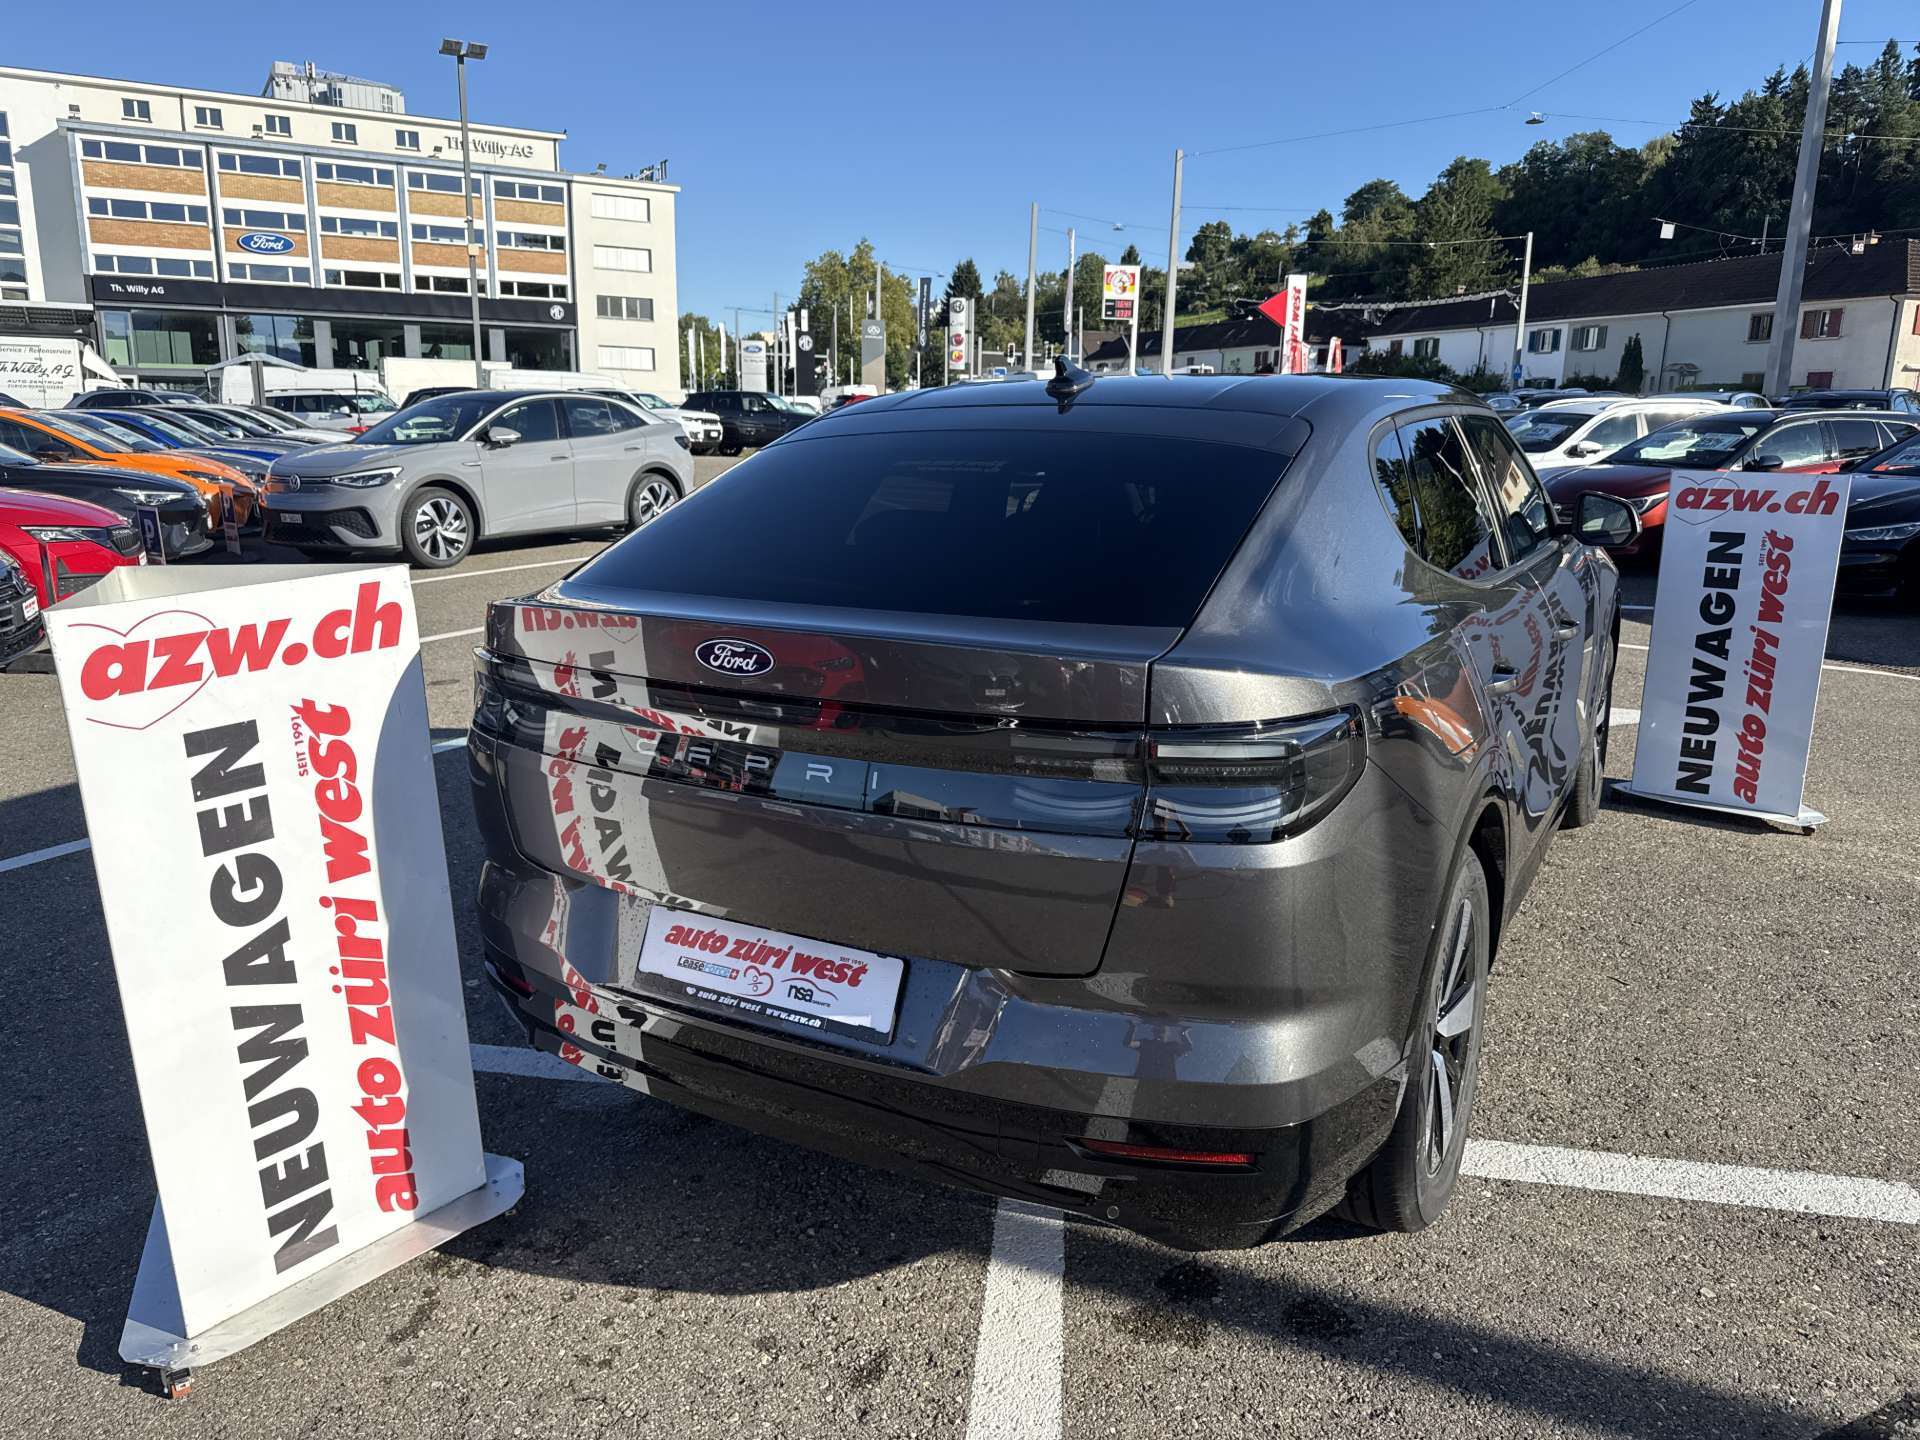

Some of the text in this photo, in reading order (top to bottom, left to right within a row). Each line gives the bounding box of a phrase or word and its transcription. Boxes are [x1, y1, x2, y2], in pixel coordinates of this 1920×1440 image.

[472, 138, 507, 159] Willy
[510, 144, 534, 159] AG
[110, 284, 165, 296] Th. Willy AG
[10, 361, 49, 378] Willy
[51, 364, 75, 379] AG
[1675, 480, 1840, 516] azw.ch
[81, 581, 403, 701] azw.ch
[709, 643, 758, 672] Ford
[1675, 531, 1746, 795] NEUWAGEN
[1733, 529, 1794, 805] auto züri west
[291, 715, 309, 777] SEIT 1991
[289, 698, 419, 1213] auto züri west
[664, 924, 869, 988] auto züri west
[183, 719, 340, 1275] NEUWAGEN
[697, 990, 822, 1028] auto züri west www.azw.ch
[787, 984, 815, 1003] nsa
